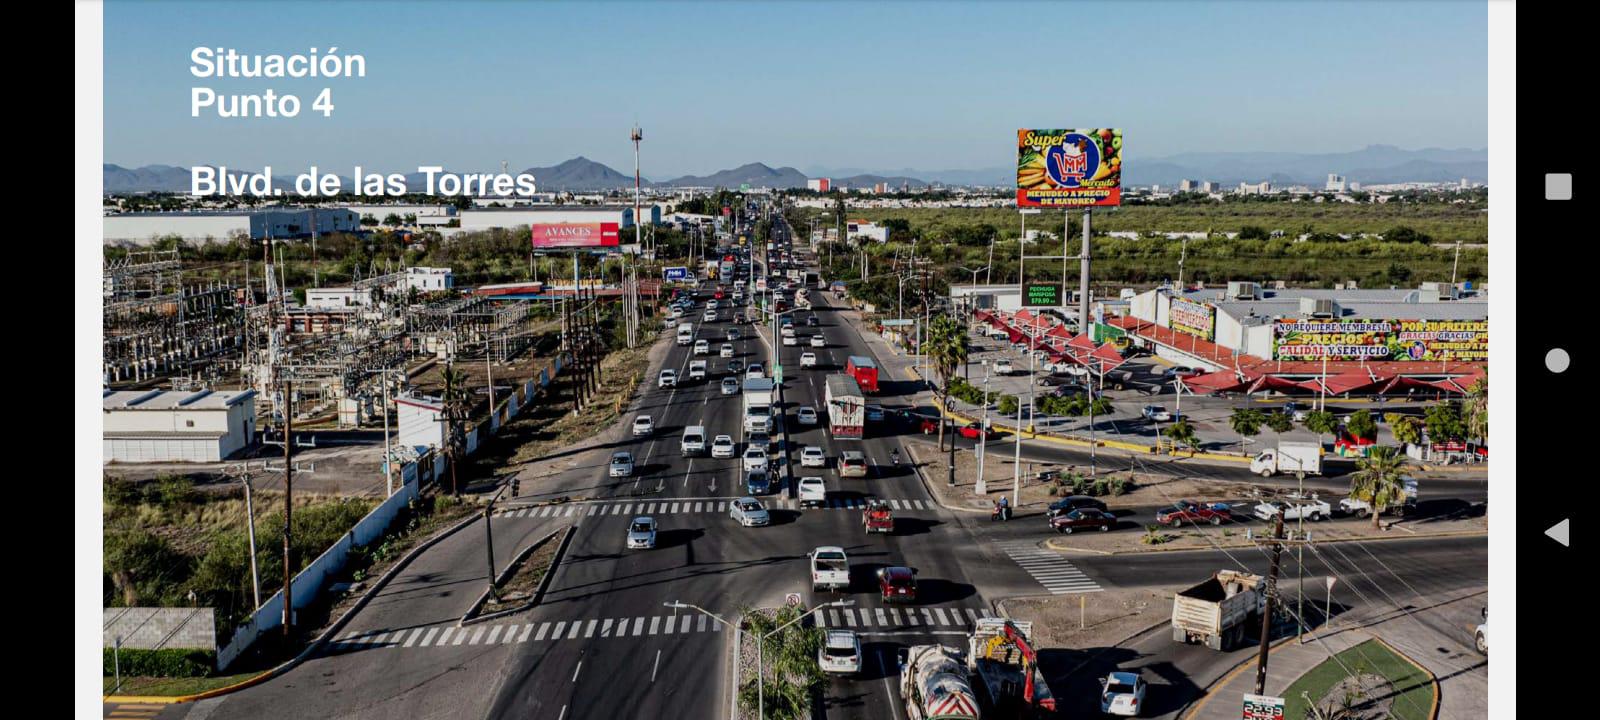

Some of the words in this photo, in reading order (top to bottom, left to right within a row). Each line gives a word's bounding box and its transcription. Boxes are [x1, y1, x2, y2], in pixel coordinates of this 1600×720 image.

[1024, 132, 1066, 149] Super
[1080, 179, 1114, 187] Mercado
[1026, 190, 1068, 198] MENUDEO
[1070, 190, 1077, 198] A
[1078, 190, 1110, 198] PRECIO
[545, 227, 591, 236] AVANCES
[1279, 323, 1291, 331] NO
[1293, 323, 1336, 332] REQUIERE
[1401, 322, 1423, 331] POR
[1425, 322, 1438, 331] SU
[1302, 333, 1364, 344] PRECIOS
[1400, 332, 1436, 340] GRACIAS
[1438, 332, 1474, 340] GRACIAS
[1328, 346, 1336, 355] Y
[1337, 346, 1388, 355] SERVICIO
[1430, 342, 1471, 350] MENUDEO
[1472, 342, 1478, 350] A
